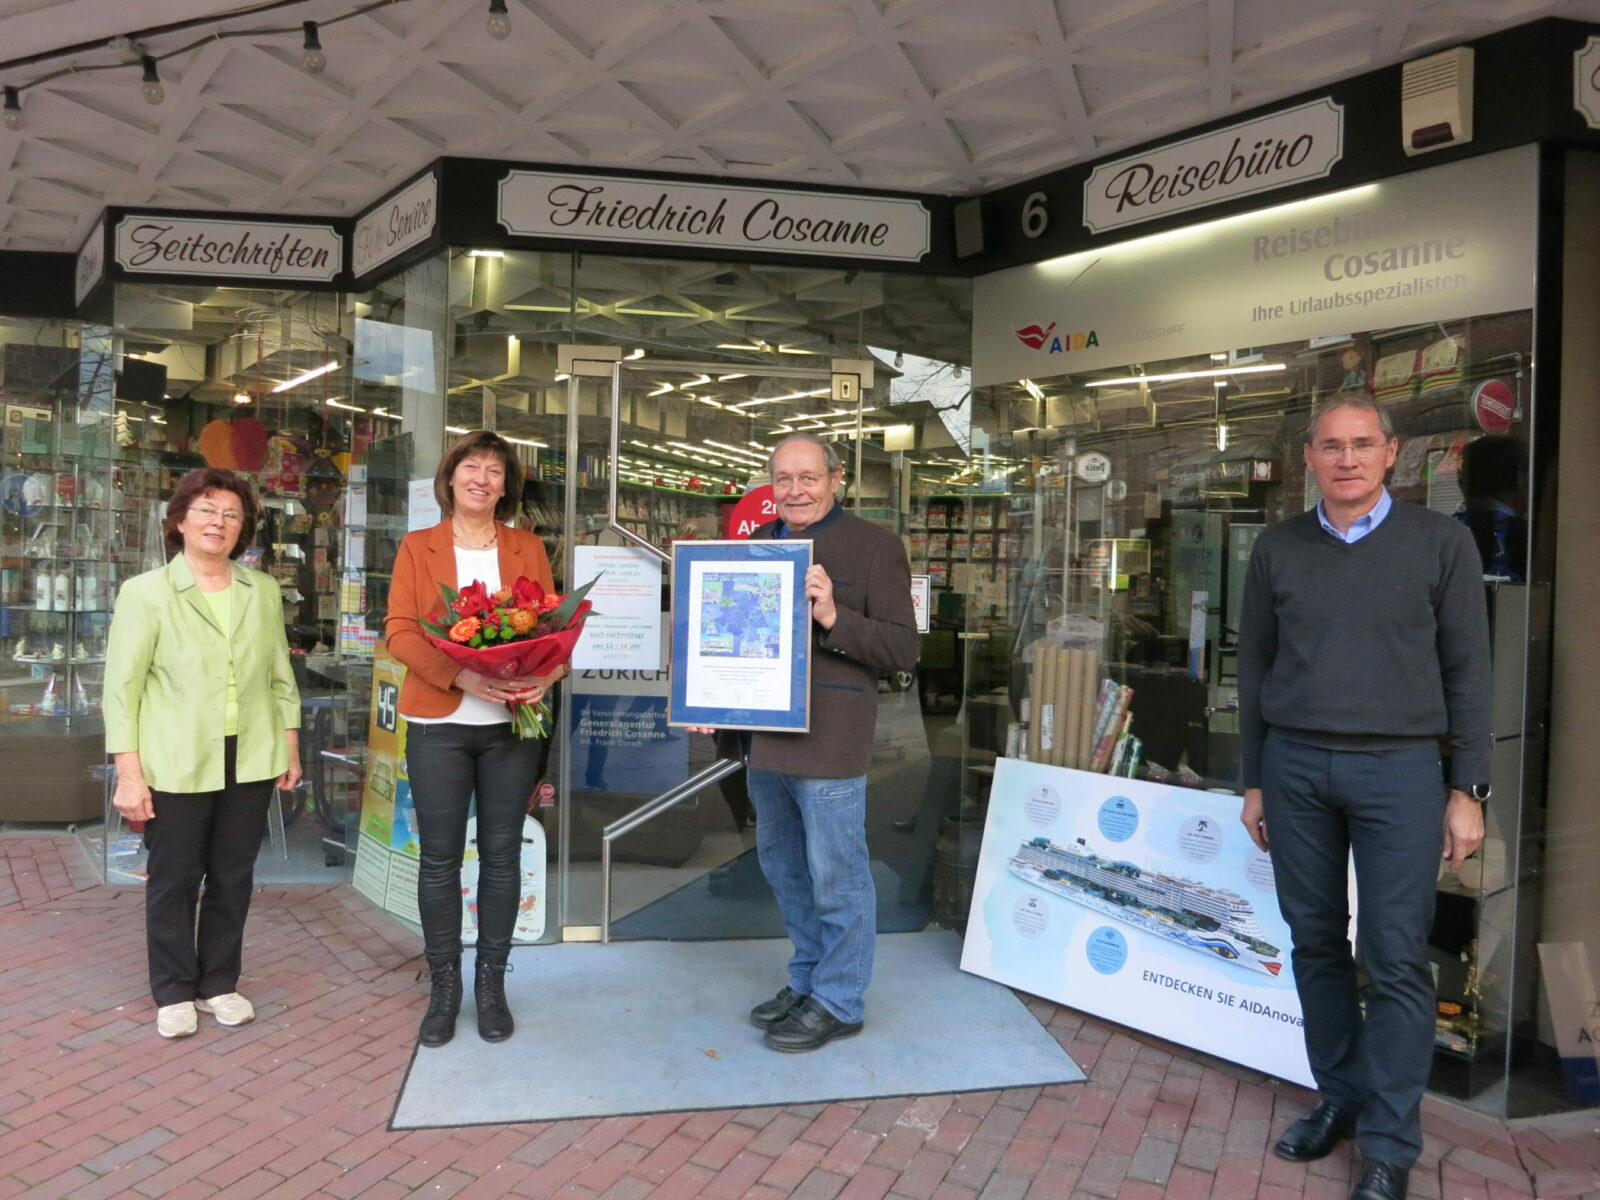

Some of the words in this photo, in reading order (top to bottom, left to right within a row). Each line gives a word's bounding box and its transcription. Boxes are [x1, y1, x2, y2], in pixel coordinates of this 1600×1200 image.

[1105, 134, 1313, 213] Reisebüro
[387, 199, 432, 247] Service
[548, 184, 727, 235] Friedrich
[742, 199, 889, 246] Cosanne
[1021, 192, 1048, 238] 6
[1254, 209, 1409, 262] Reisebüro
[129, 224, 329, 274] Zeitschriften
[1324, 234, 1468, 282] Cosanne
[1252, 304, 1284, 322] Ihre
[1290, 273, 1467, 316] Urlaubsspezialisten
[1049, 330, 1099, 354] AIDA
[580, 719, 656, 729] Generalagentur
[580, 728, 622, 737] Friedrich
[625, 730, 666, 739] Cosanne
[592, 710, 666, 719] Versicherungspartne
[1142, 970, 1214, 1000] ENTDECKEN
[1216, 991, 1236, 1008] SIE
[1239, 998, 1304, 1028] AIDAnova
